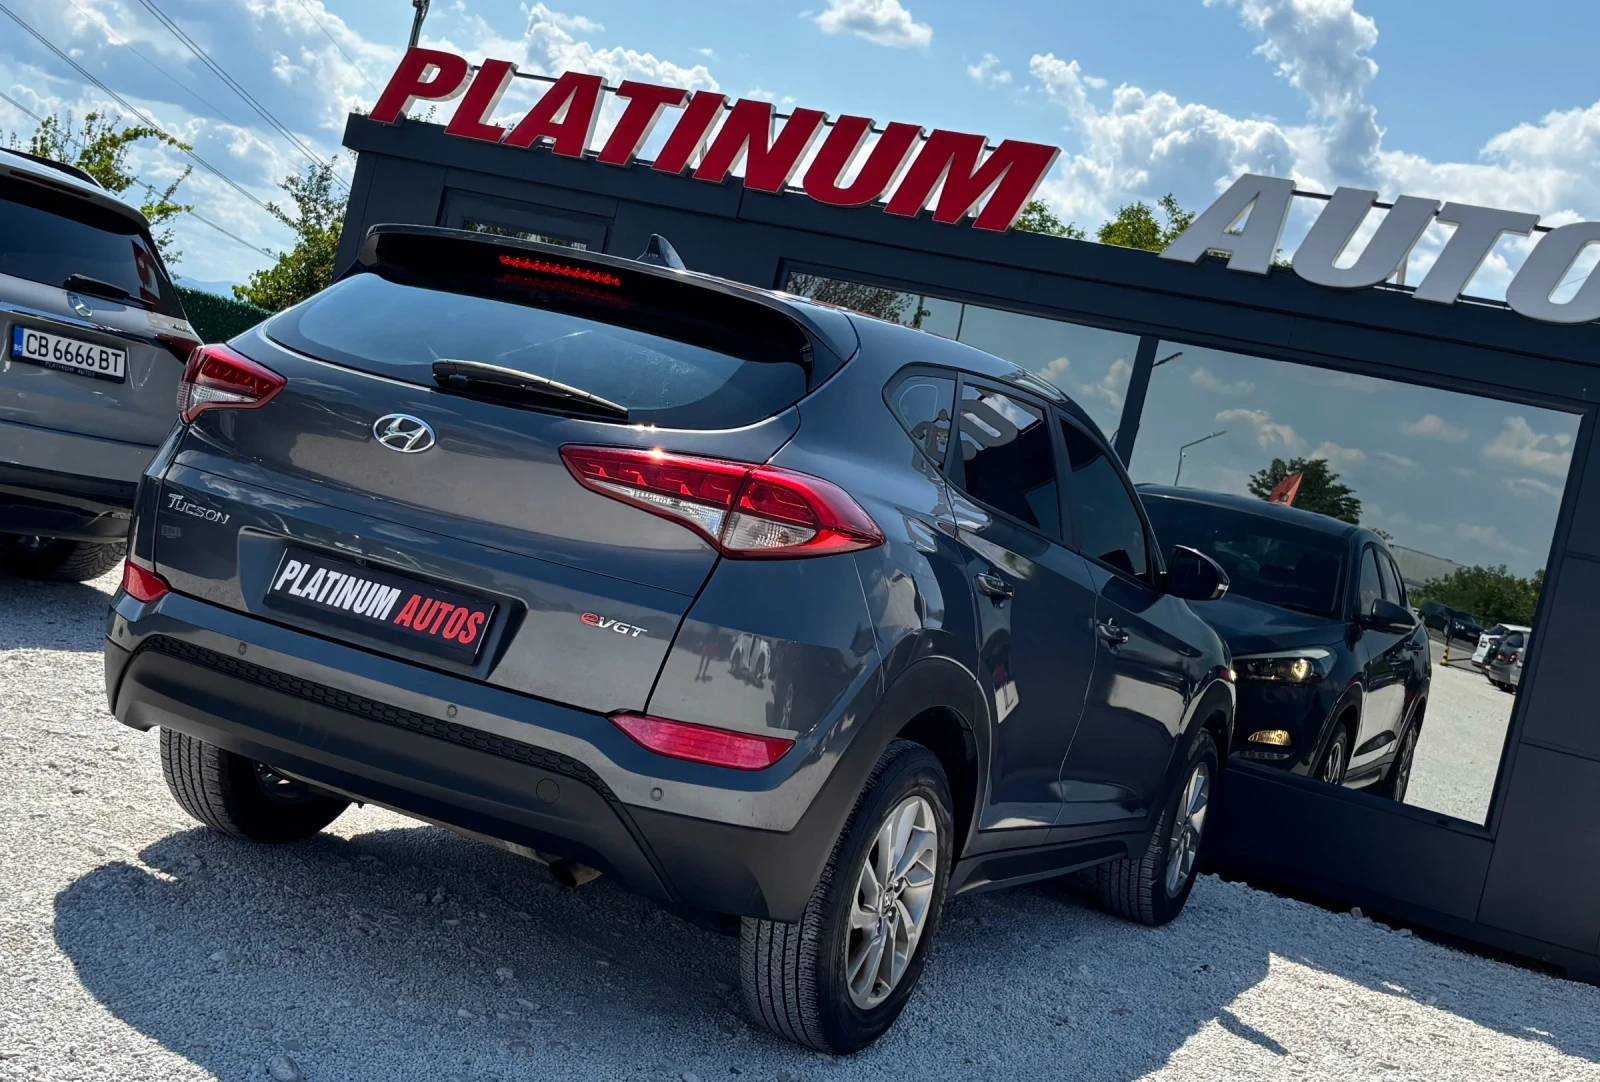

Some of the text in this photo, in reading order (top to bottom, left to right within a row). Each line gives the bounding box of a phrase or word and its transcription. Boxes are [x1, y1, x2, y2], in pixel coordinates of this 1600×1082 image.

[366, 47, 1600, 325] PLATINUM AUTO
[26, 333, 122, 373] CB 6666 BT
[44, 361, 75, 373] PLATINUM
[274, 559, 485, 645] PLATINUM AUTOS
